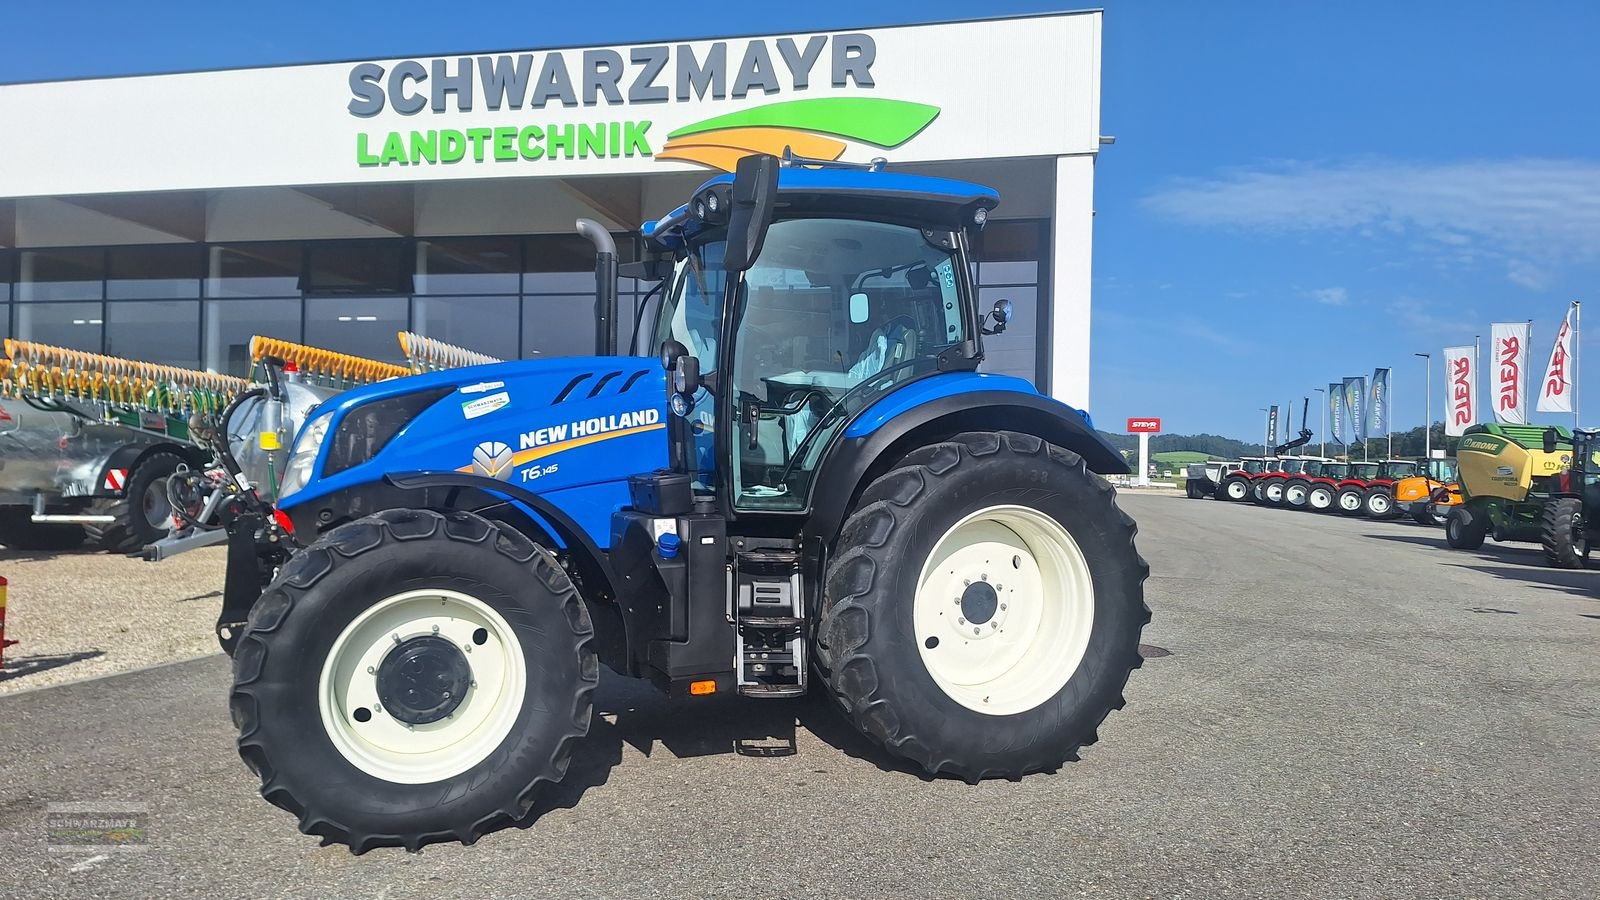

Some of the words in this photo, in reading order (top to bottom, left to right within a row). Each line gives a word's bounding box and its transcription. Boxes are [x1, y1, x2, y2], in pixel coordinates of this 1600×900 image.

[348, 33, 877, 117] SCHWARZMAYR
[357, 120, 652, 168] LANDTECHNIK
[519, 424, 568, 450] NEW
[571, 408, 659, 438] HOLLAND
[1471, 441, 1499, 451] KRONE
